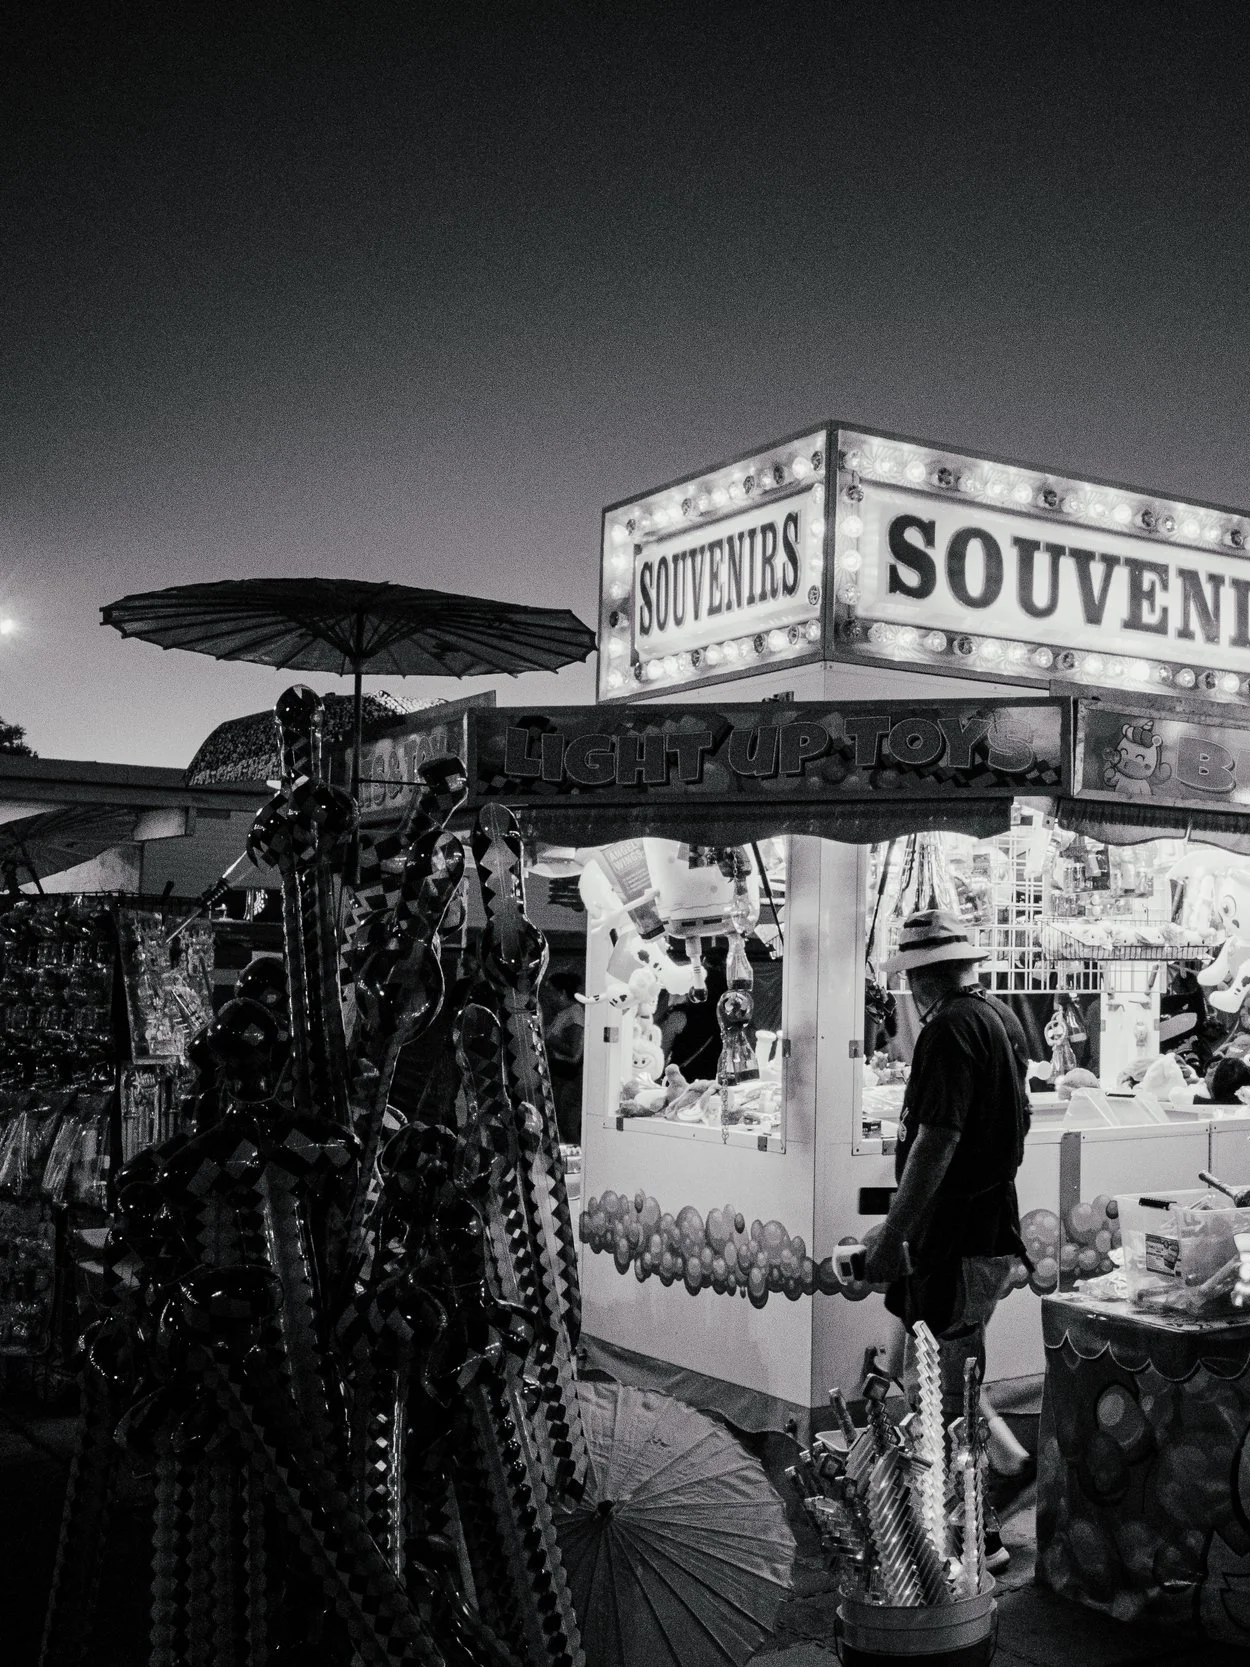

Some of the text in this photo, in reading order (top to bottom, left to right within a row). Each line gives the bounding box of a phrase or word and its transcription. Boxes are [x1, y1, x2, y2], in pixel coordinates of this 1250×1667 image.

[639, 511, 801, 636] SOUVENIRS
[504, 716, 1036, 785] LIGHT UP TOYS
